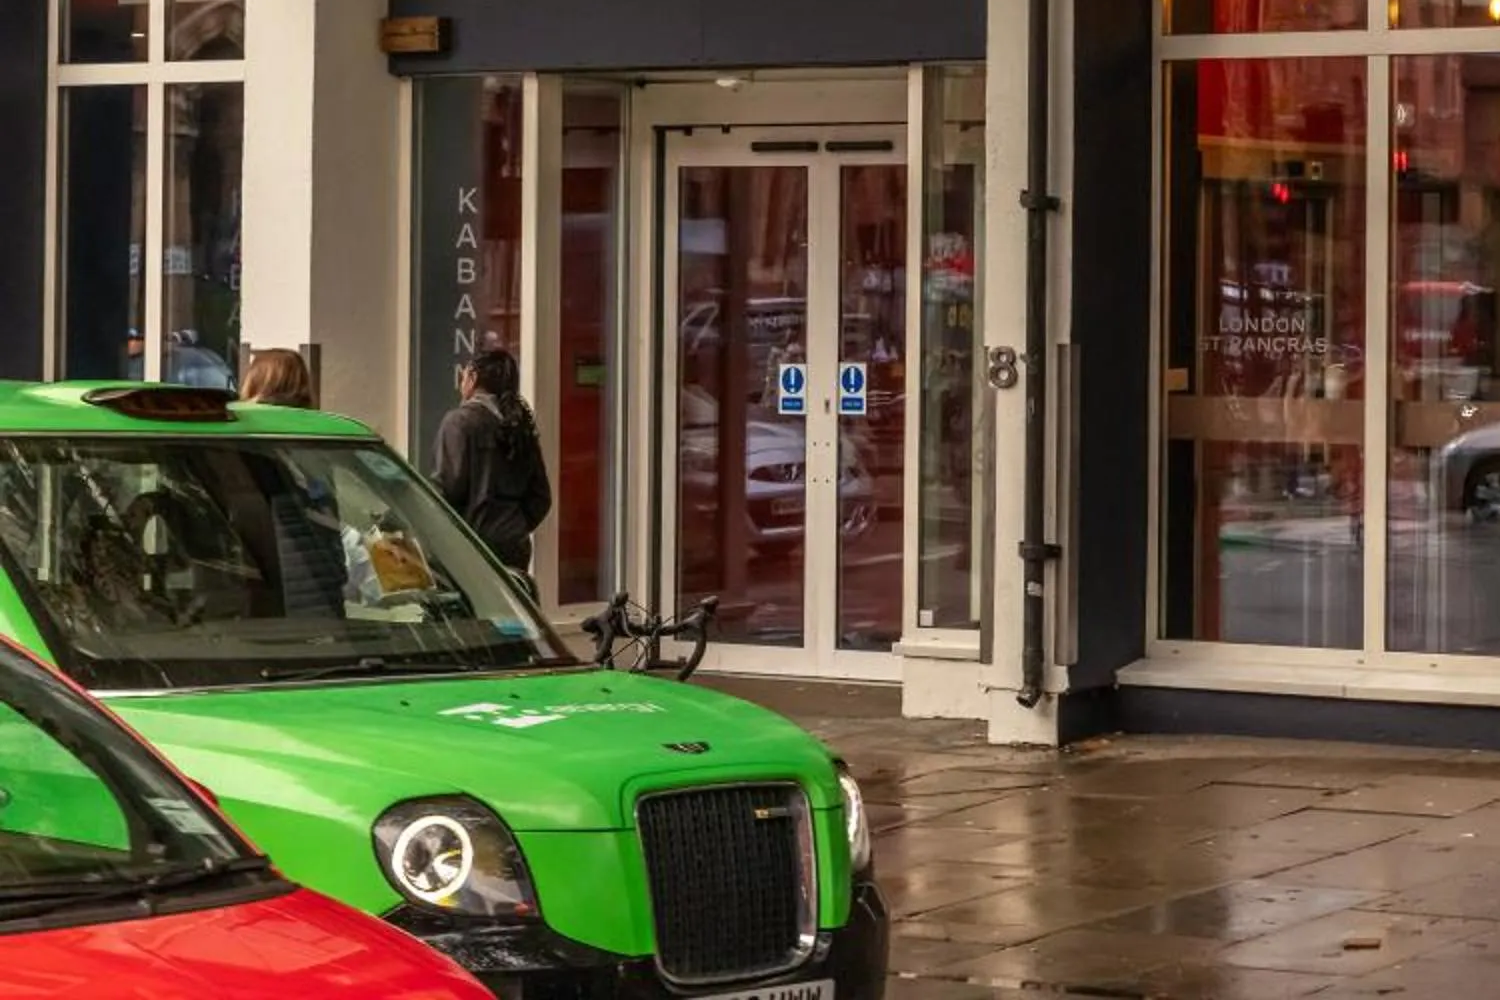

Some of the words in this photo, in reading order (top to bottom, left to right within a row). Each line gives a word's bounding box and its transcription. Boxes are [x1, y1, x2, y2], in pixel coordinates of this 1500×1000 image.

[1219, 317, 1306, 333] LONDON
[1225, 337, 1329, 353] PANCRAS
[990, 346, 1018, 389] 8
